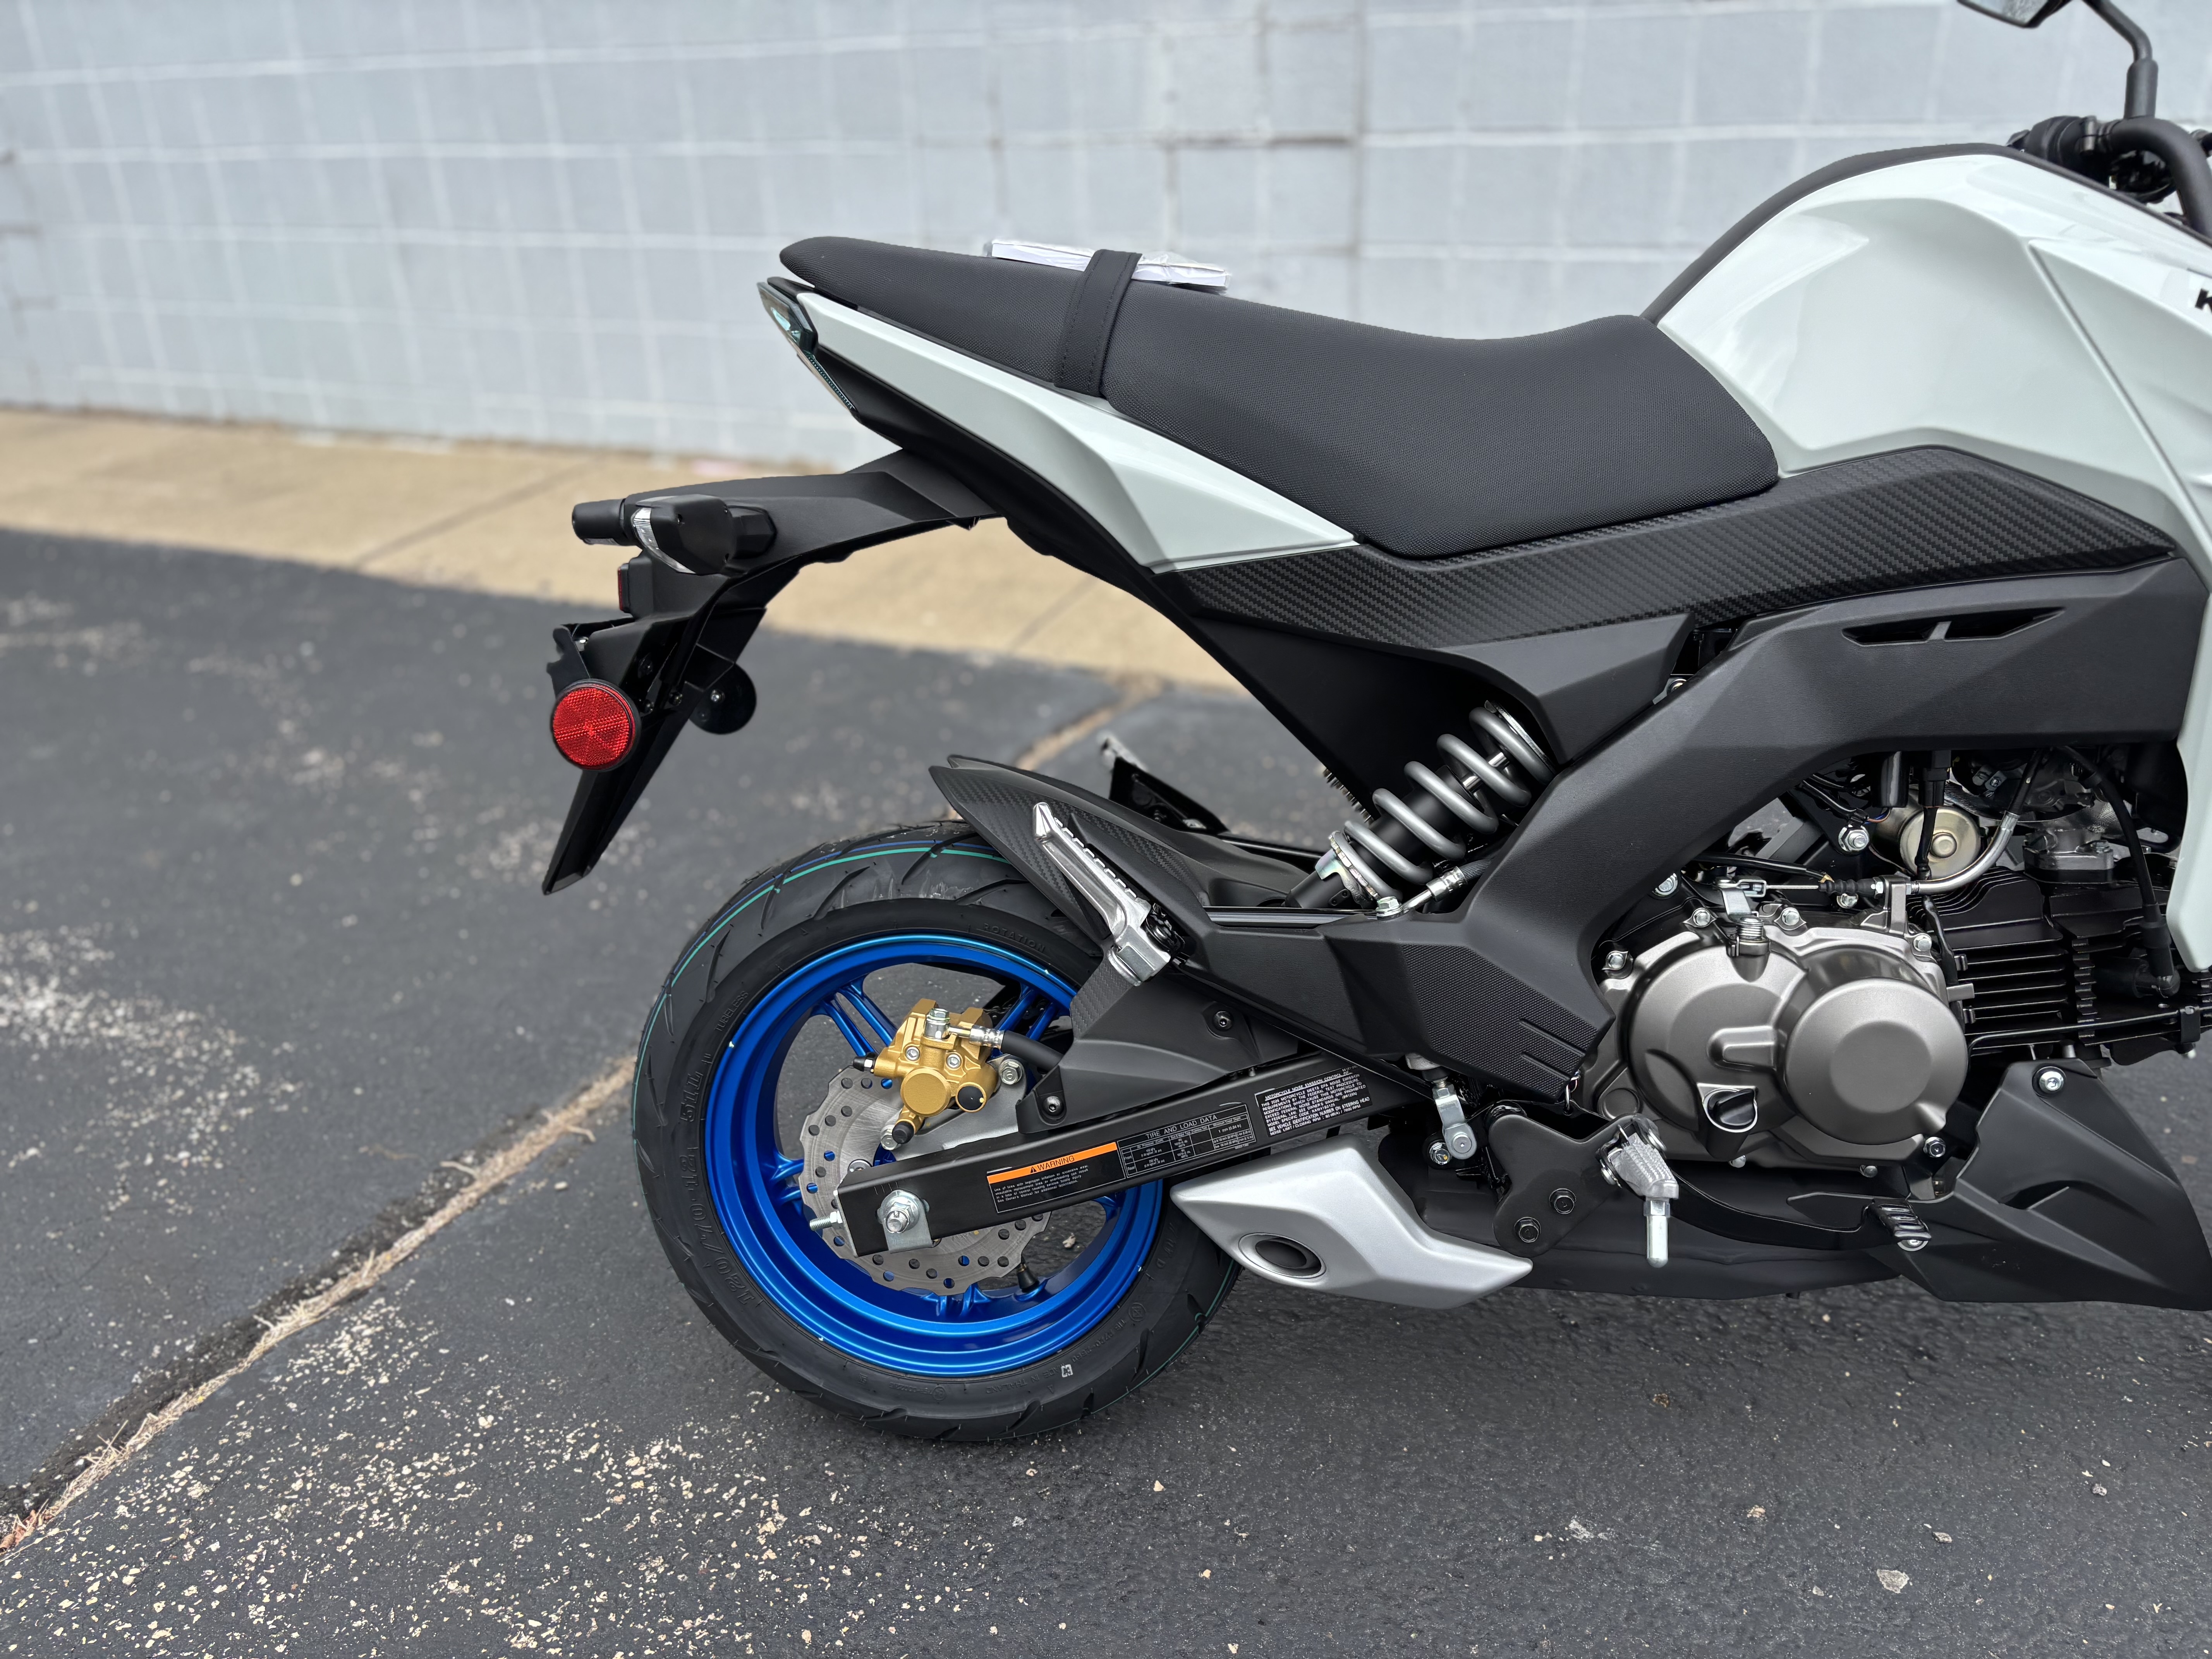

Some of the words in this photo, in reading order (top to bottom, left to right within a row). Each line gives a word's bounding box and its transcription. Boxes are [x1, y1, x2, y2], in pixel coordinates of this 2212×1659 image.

[983, 922, 1046, 953] ROTATION
[715, 991, 749, 1034] TUBELESS
[1280, 1090, 1306, 1101] MOTORCYCLE
[1341, 1099, 1359, 1109] STEERING
[1145, 1130, 1161, 1139] TIRE
[1163, 1125, 1177, 1134] AND
[1179, 1120, 1197, 1130] LOAD
[1199, 1114, 1218, 1124] DATA
[1037, 1155, 1075, 1171] WARNING
[1013, 1183, 1034, 1192] replacement
[1049, 1173, 1070, 1182] overloading
[985, 1379, 1028, 1394] THAILAND
[1031, 1374, 1041, 1383] IN
